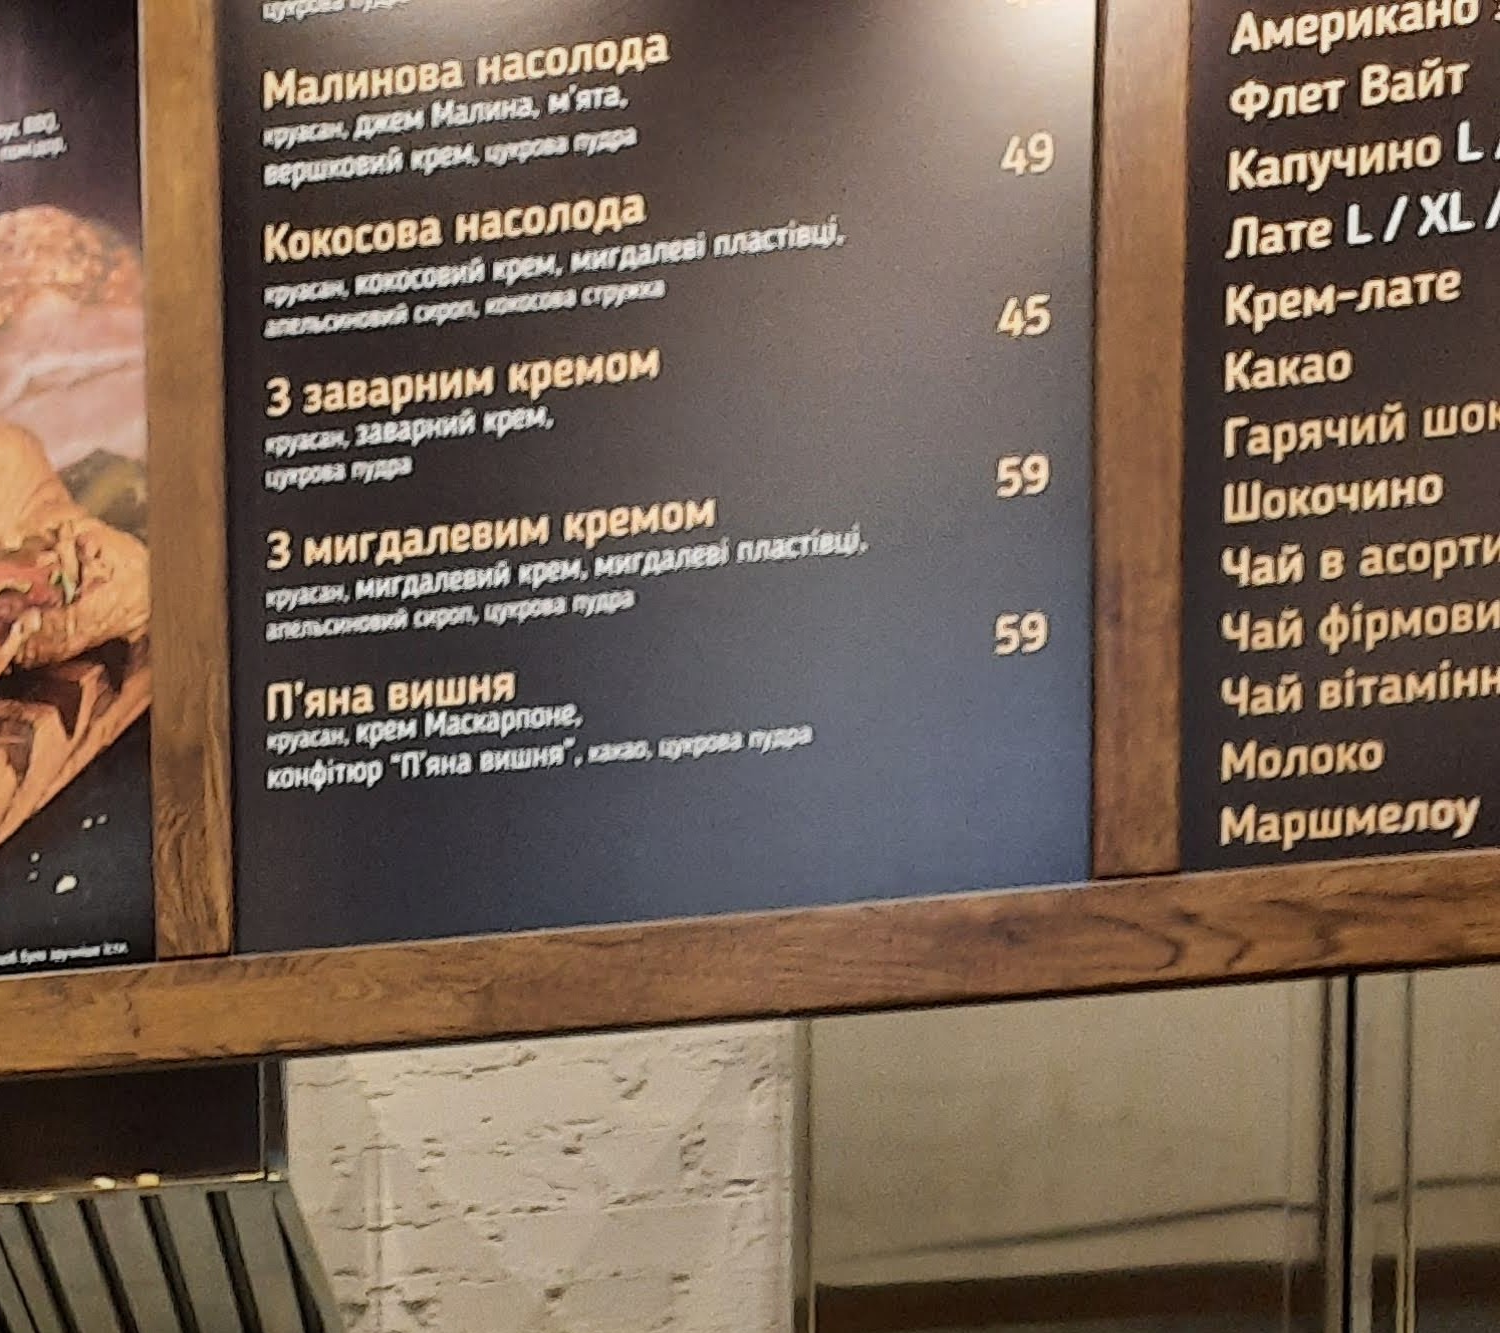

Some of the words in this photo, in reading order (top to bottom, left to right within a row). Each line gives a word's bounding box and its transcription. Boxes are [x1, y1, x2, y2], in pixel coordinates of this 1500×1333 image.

[1230, 0, 1480, 54] Американо
[262, 58, 464, 111] Малинова
[476, 32, 670, 86] насолода
[1229, 76, 1348, 123] Флет
[1359, 57, 1471, 108] Вайт
[1002, 132, 1055, 176] 49
[1227, 132, 1443, 194] Капучино
[264, 215, 444, 264] Кокосова
[454, 193, 647, 246] насолода
[1224, 215, 1333, 260] Лате
[996, 293, 1053, 338] 45
[1224, 269, 1463, 335] Крем-лате
[302, 360, 494, 415] заварним
[508, 346, 661, 395] кремом
[1224, 347, 1353, 393] Какао
[1222, 400, 1407, 464] Гарячий
[996, 454, 1051, 497] 59
[1223, 473, 1444, 525] Шокочино
[303, 514, 551, 569] мигдалевим
[563, 496, 716, 548] кремом
[356, 563, 510, 604] мигдалевий
[594, 540, 729, 582] мигдалеві
[1221, 542, 1305, 587] Чай
[1221, 611, 1304, 652] Чай
[388, 673, 515, 713] вишня
[1221, 675, 1303, 717] Чай
[356, 715, 417, 746] крем
[424, 701, 583, 742] Маскарпоне,
[266, 756, 382, 793] конфітюр
[1220, 739, 1385, 782] Молоко
[1218, 796, 1481, 851] Маршмелоу
